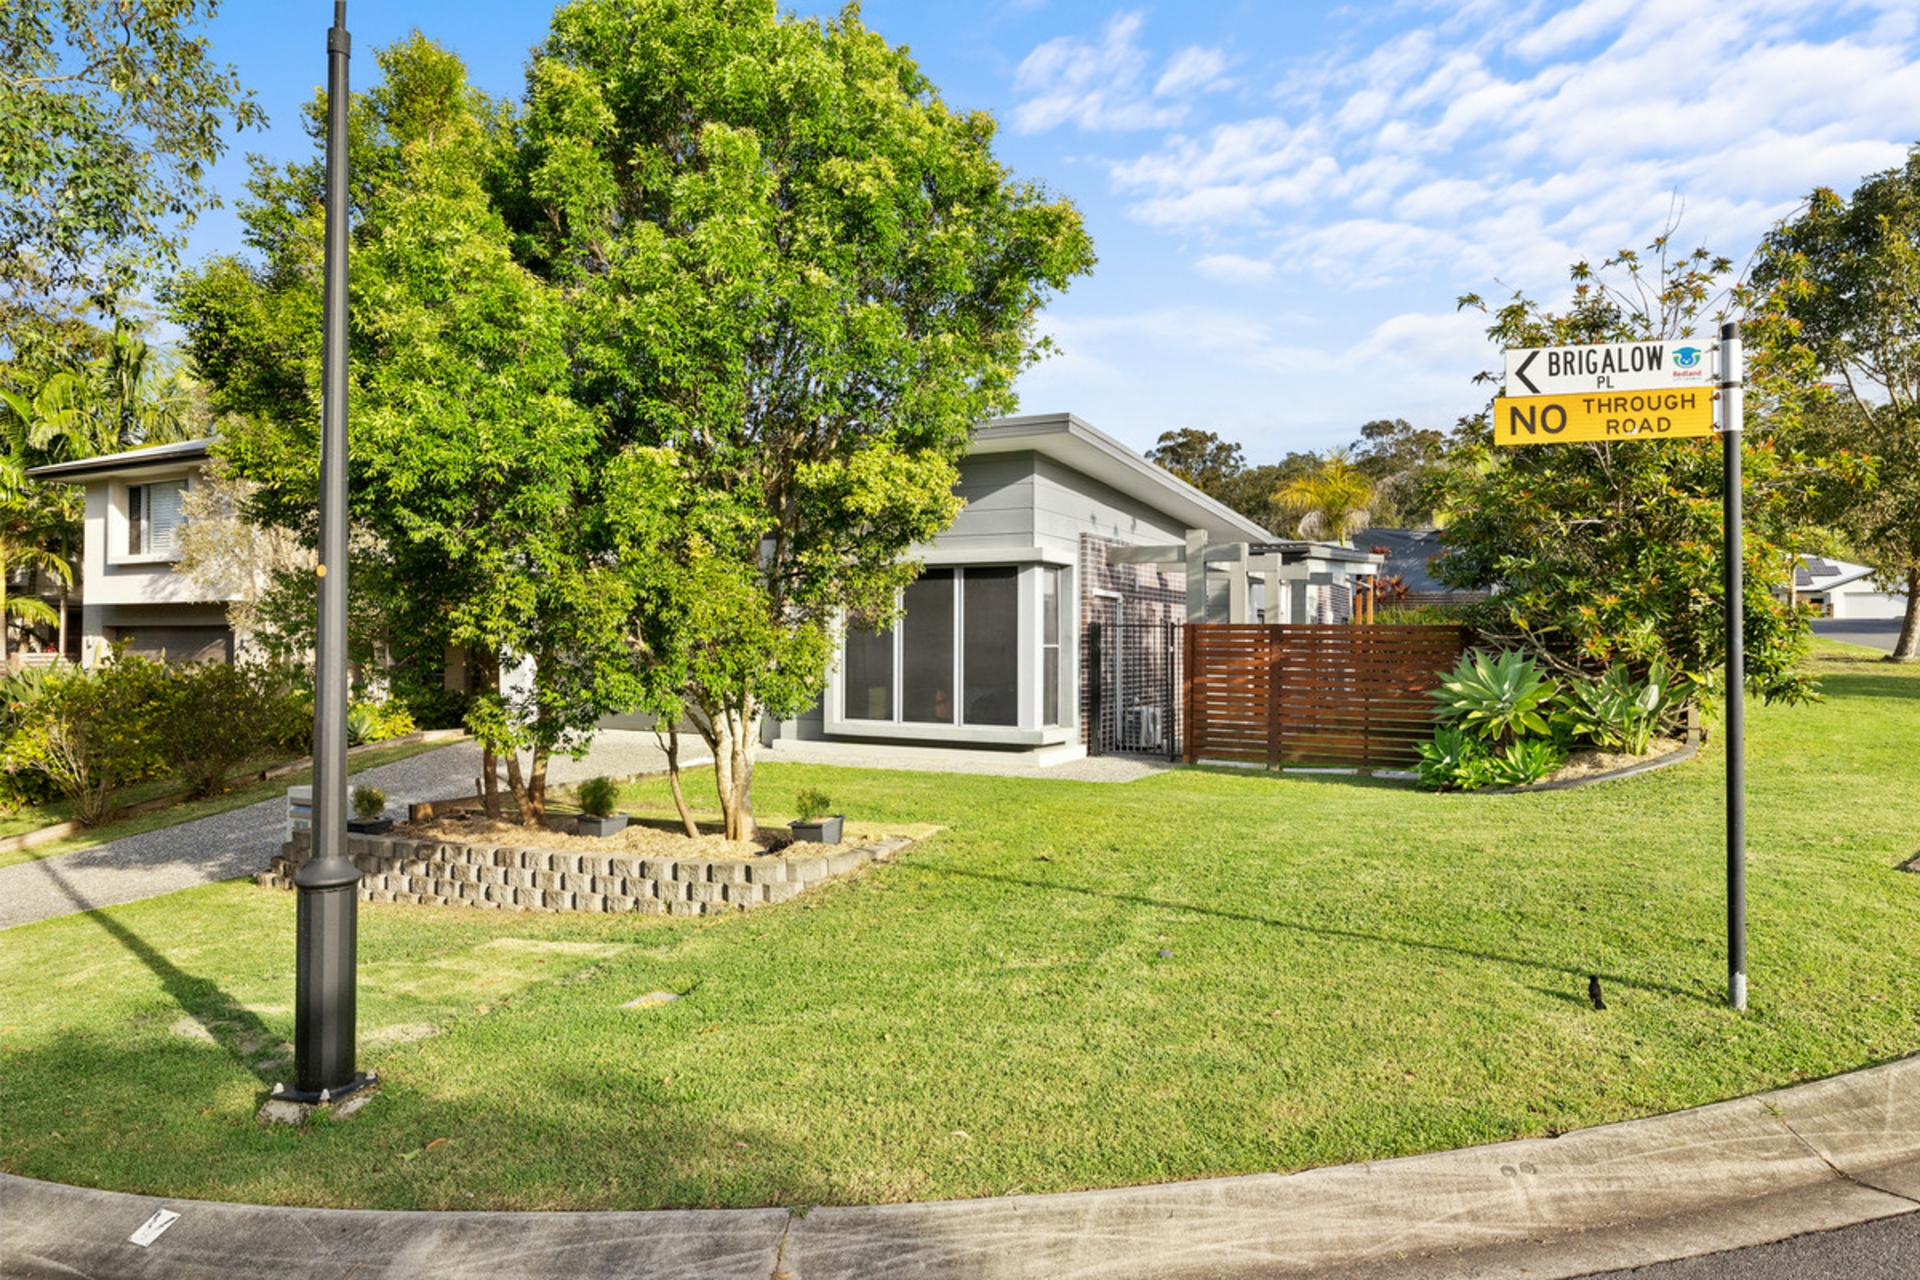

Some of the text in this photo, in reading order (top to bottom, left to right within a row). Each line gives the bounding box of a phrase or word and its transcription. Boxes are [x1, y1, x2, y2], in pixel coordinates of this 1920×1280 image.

[1549, 345, 1663, 377] BRIGALOW
[1596, 376, 1614, 389] PL
[1672, 369, 1702, 377] Redland
[1582, 393, 1696, 414] THROUGH
[1509, 403, 1568, 435] NO
[1606, 417, 1671, 435] ROAD
